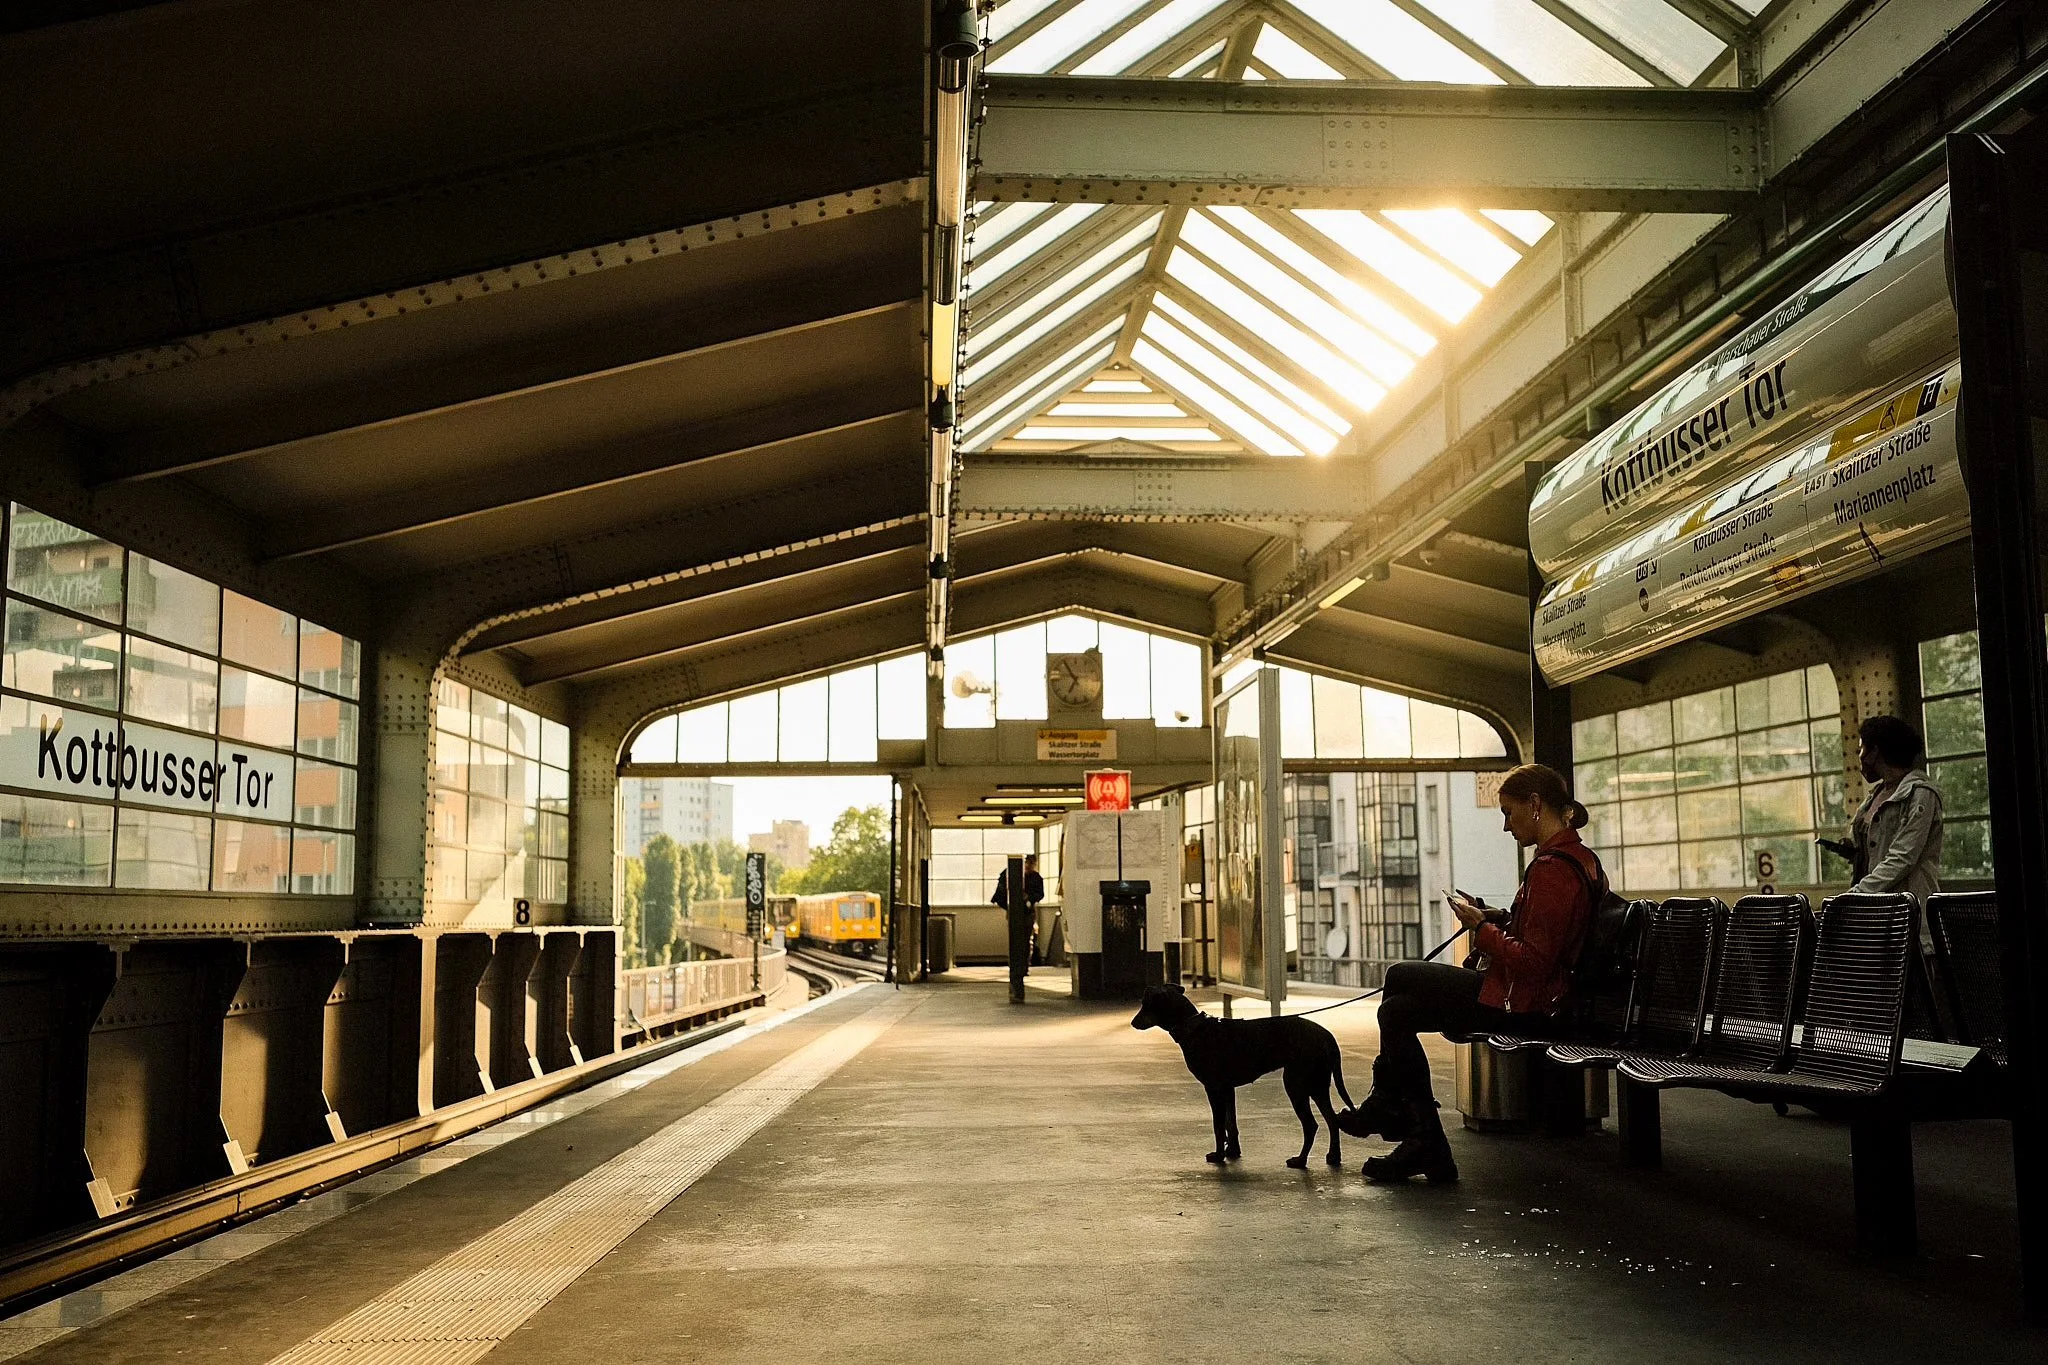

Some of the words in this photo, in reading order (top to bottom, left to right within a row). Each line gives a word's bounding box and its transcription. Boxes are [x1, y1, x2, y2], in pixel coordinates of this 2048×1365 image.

[1772, 295, 1808, 332] Straße
[1600, 397, 1731, 515] Kottbusser
[1739, 359, 1788, 429] Tor
[1832, 446, 1884, 488] Skalitzer
[1887, 421, 1931, 461] Straße
[1804, 474, 1827, 495] EASY
[1833, 463, 1936, 525] Mariannenplatz
[1693, 516, 1740, 553] Kottbusser
[1742, 498, 1774, 530] Straße
[1743, 532, 1776, 563] Straße
[37, 714, 227, 803] Kottbusser
[232, 753, 274, 809] Tor
[1098, 801, 1118, 811] SOS
[1759, 853, 1774, 877] 6
[516, 899, 530, 925] 8
